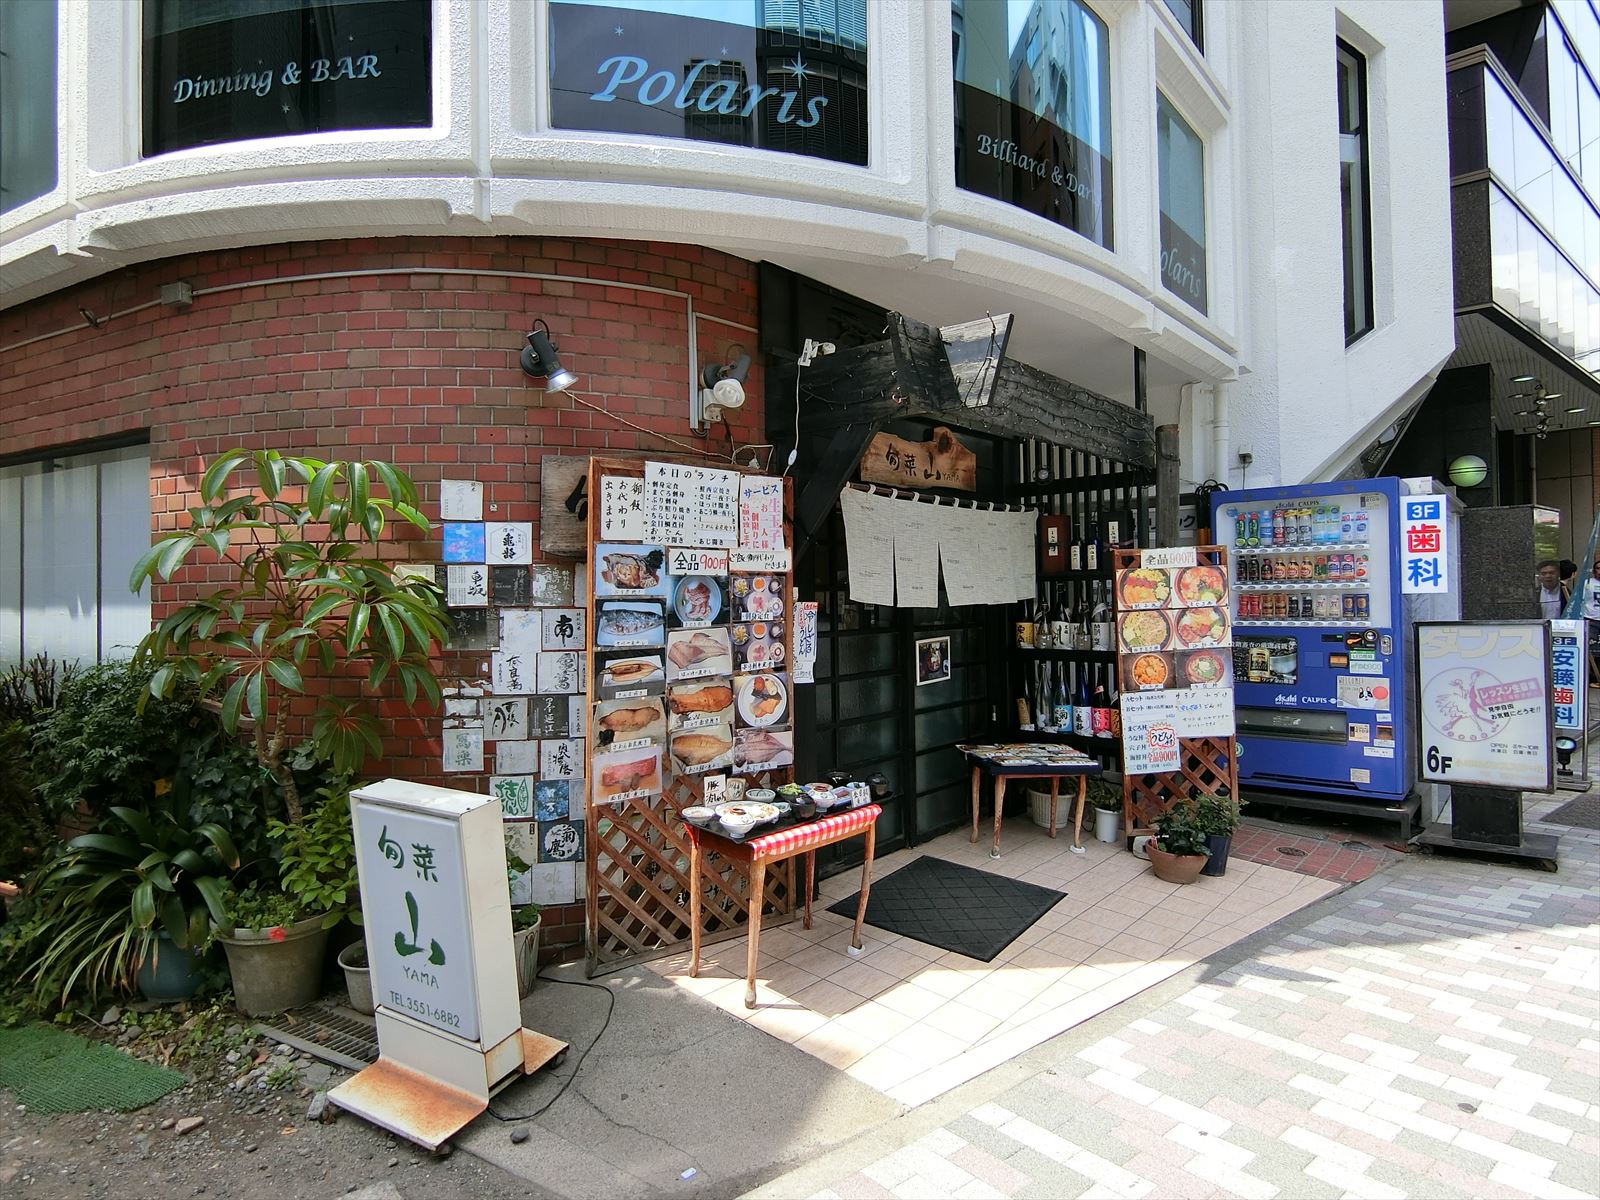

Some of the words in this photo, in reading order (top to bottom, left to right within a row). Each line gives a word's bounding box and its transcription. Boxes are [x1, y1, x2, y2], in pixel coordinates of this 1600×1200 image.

[173, 68, 273, 104] Dinning
[281, 61, 301, 85] &
[311, 54, 382, 82] BAR
[590, 55, 828, 127] Polaris
[977, 134, 1046, 178] Billiard
[1051, 166, 1063, 186] &
[1161, 248, 1201, 297] olaris
[653, 481, 679, 490] 刺身定食
[658, 467, 729, 483] 本日のランチ
[605, 481, 613, 530] 出きます
[617, 480, 628, 528] お代わり
[651, 497, 678, 506] ぶり刺身
[653, 489, 685, 498] まぐろ刺身
[743, 485, 779, 499] サービス
[1411, 504, 1435, 519] 3F
[674, 551, 728, 571] 全品900円
[1407, 523, 1442, 587] 歯科
[553, 614, 574, 648] 南
[1420, 627, 1540, 660] ダンス
[1553, 638, 1573, 646] 3F
[1275, 694, 1297, 702] Asahi
[1302, 696, 1327, 704] CALPIS
[1552, 649, 1575, 725] 安藤歯科
[1488, 704, 1514, 713] 見学自由
[1152, 731, 1172, 744] うどん
[1426, 745, 1453, 774] 6F
[378, 825, 439, 883] 旬菜
[394, 891, 446, 966] 山
[403, 965, 440, 990] YAMA
